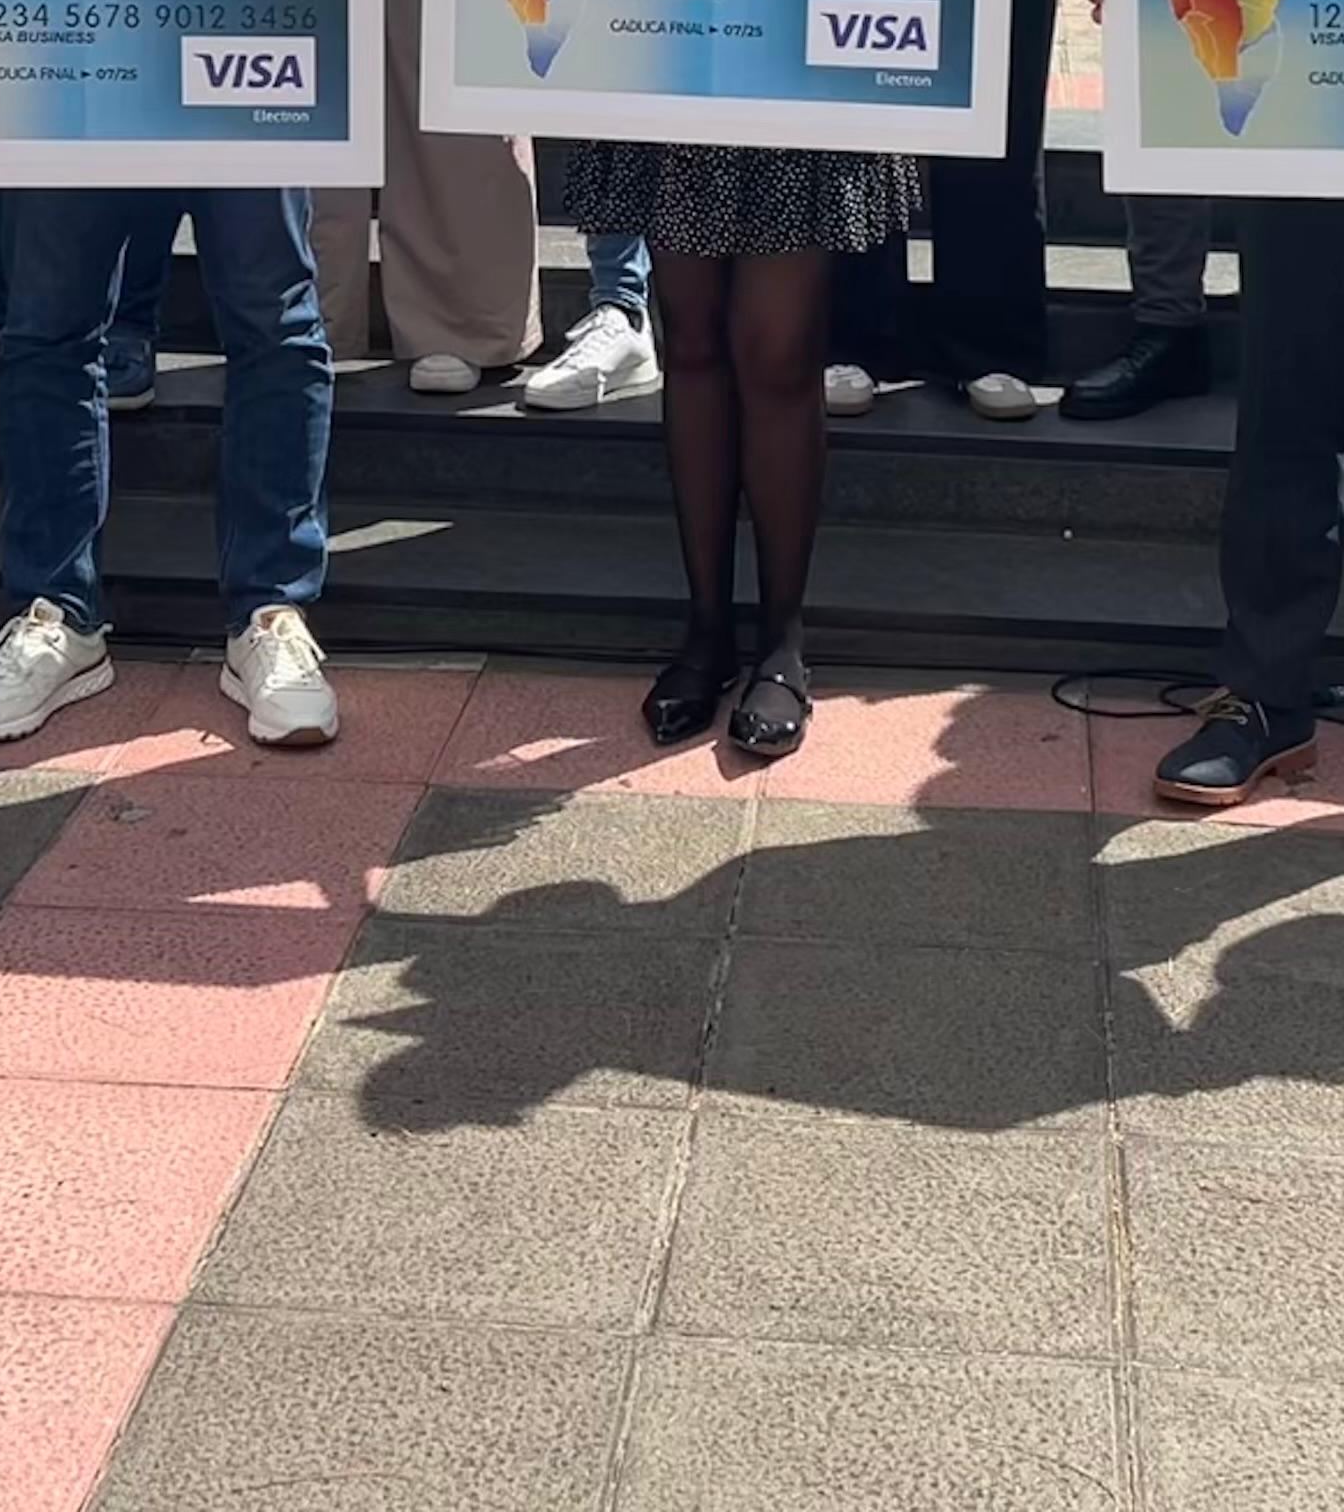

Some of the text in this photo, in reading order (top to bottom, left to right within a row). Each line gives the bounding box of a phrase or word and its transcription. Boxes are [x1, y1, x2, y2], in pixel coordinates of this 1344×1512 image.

[64, 4, 140, 28] 5678
[155, 4, 225, 29] 9012
[241, 5, 317, 30] 3456
[610, 19, 762, 37] CADUCA FINAL 07/25
[820, 12, 927, 51] VISA
[17, 32, 94, 44] BUSINESS
[40, 68, 77, 80] FINAL
[96, 68, 137, 81] 07/25
[193, 53, 303, 88] VISA
[875, 72, 932, 86] Electron
[253, 110, 309, 123] Electron
